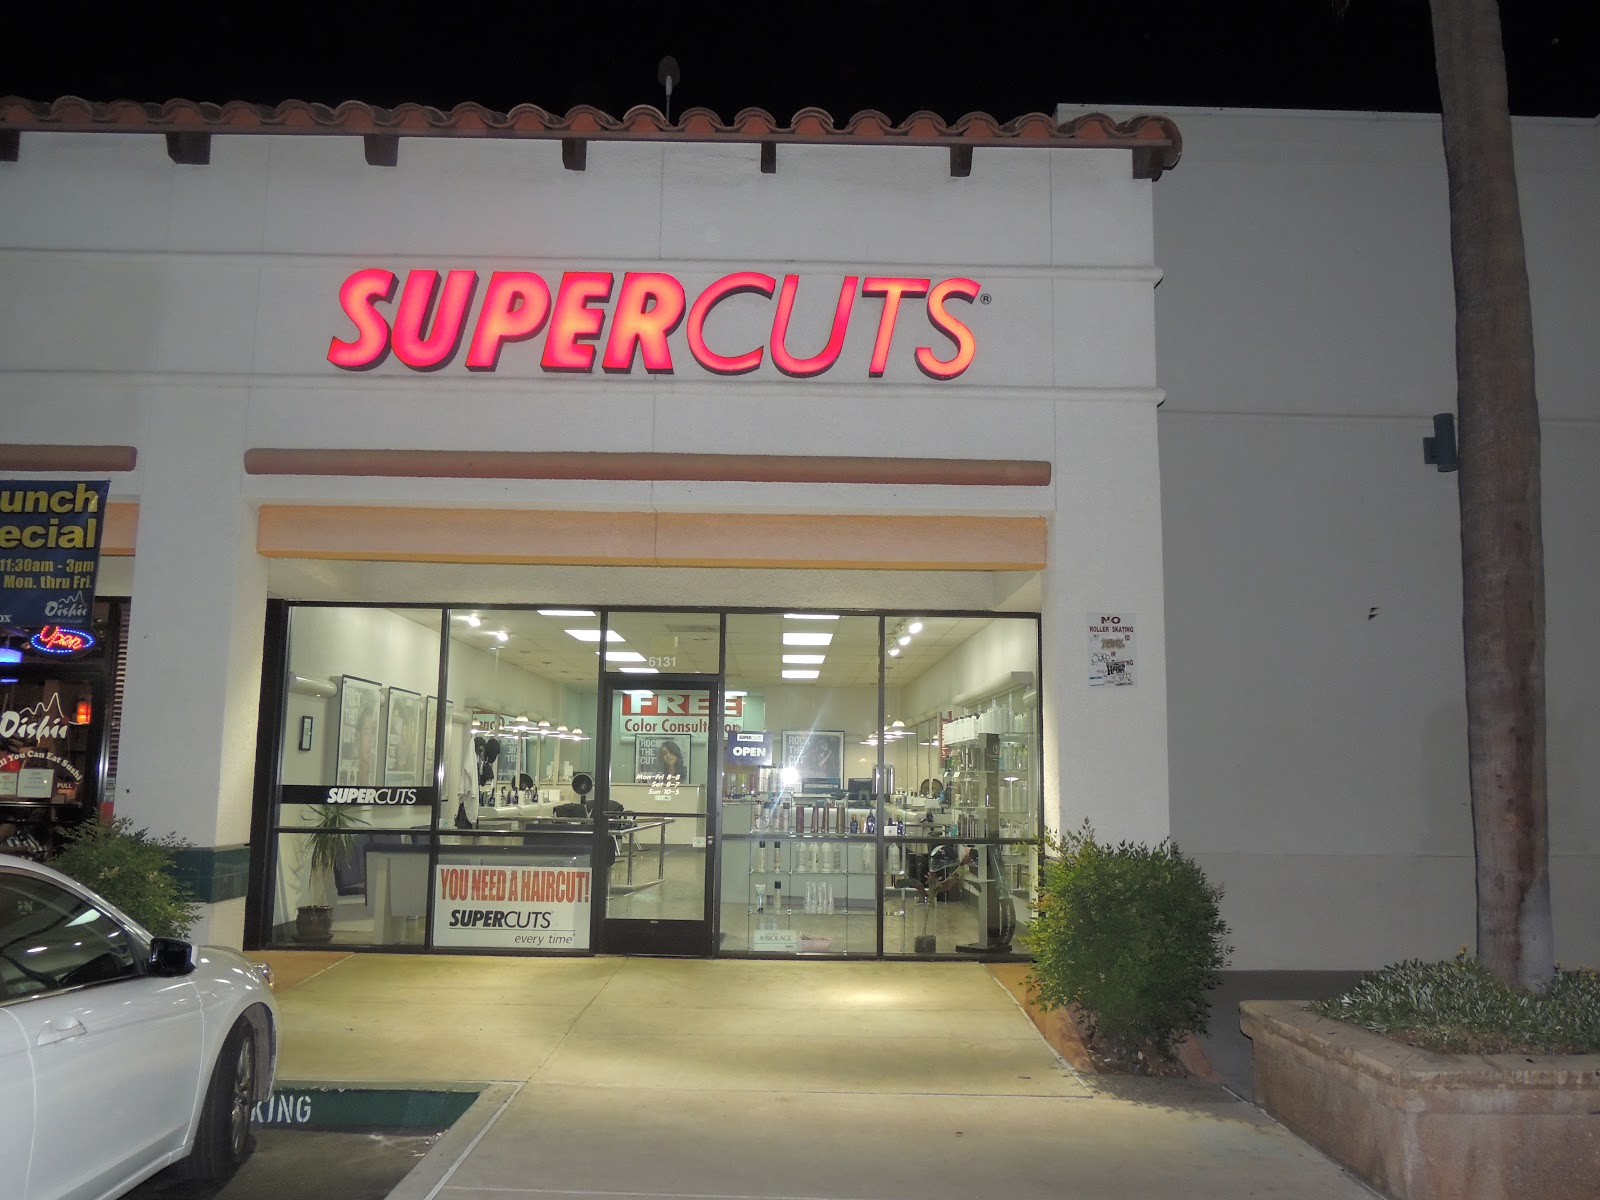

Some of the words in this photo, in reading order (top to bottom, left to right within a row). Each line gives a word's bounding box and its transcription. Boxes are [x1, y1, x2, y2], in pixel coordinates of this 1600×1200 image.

[327, 267, 982, 380] SUPERCUTS
[66, 558, 94, 574] 3pm
[4, 575, 36, 589] Mon.
[40, 575, 70, 589] thru
[1101, 616, 1121, 624] NO
[648, 656, 677, 667] 6131
[630, 694, 738, 715] FREE
[624, 718, 658, 733] Color
[8, 752, 26, 762] You
[27, 750, 46, 759] Can
[46, 752, 62, 764] Eat
[641, 748, 655, 756] THE
[732, 746, 767, 757] OPEN
[640, 756, 656, 765] CUT
[327, 787, 417, 805] SUPERCUTS
[441, 868, 469, 901] YOU
[471, 869, 507, 902] NEED
[508, 870, 519, 902] A
[521, 870, 591, 903] HAIRCUT!
[449, 909, 552, 929] SUPERCUTS
[514, 934, 545, 946] every
[548, 933, 573, 944] time
